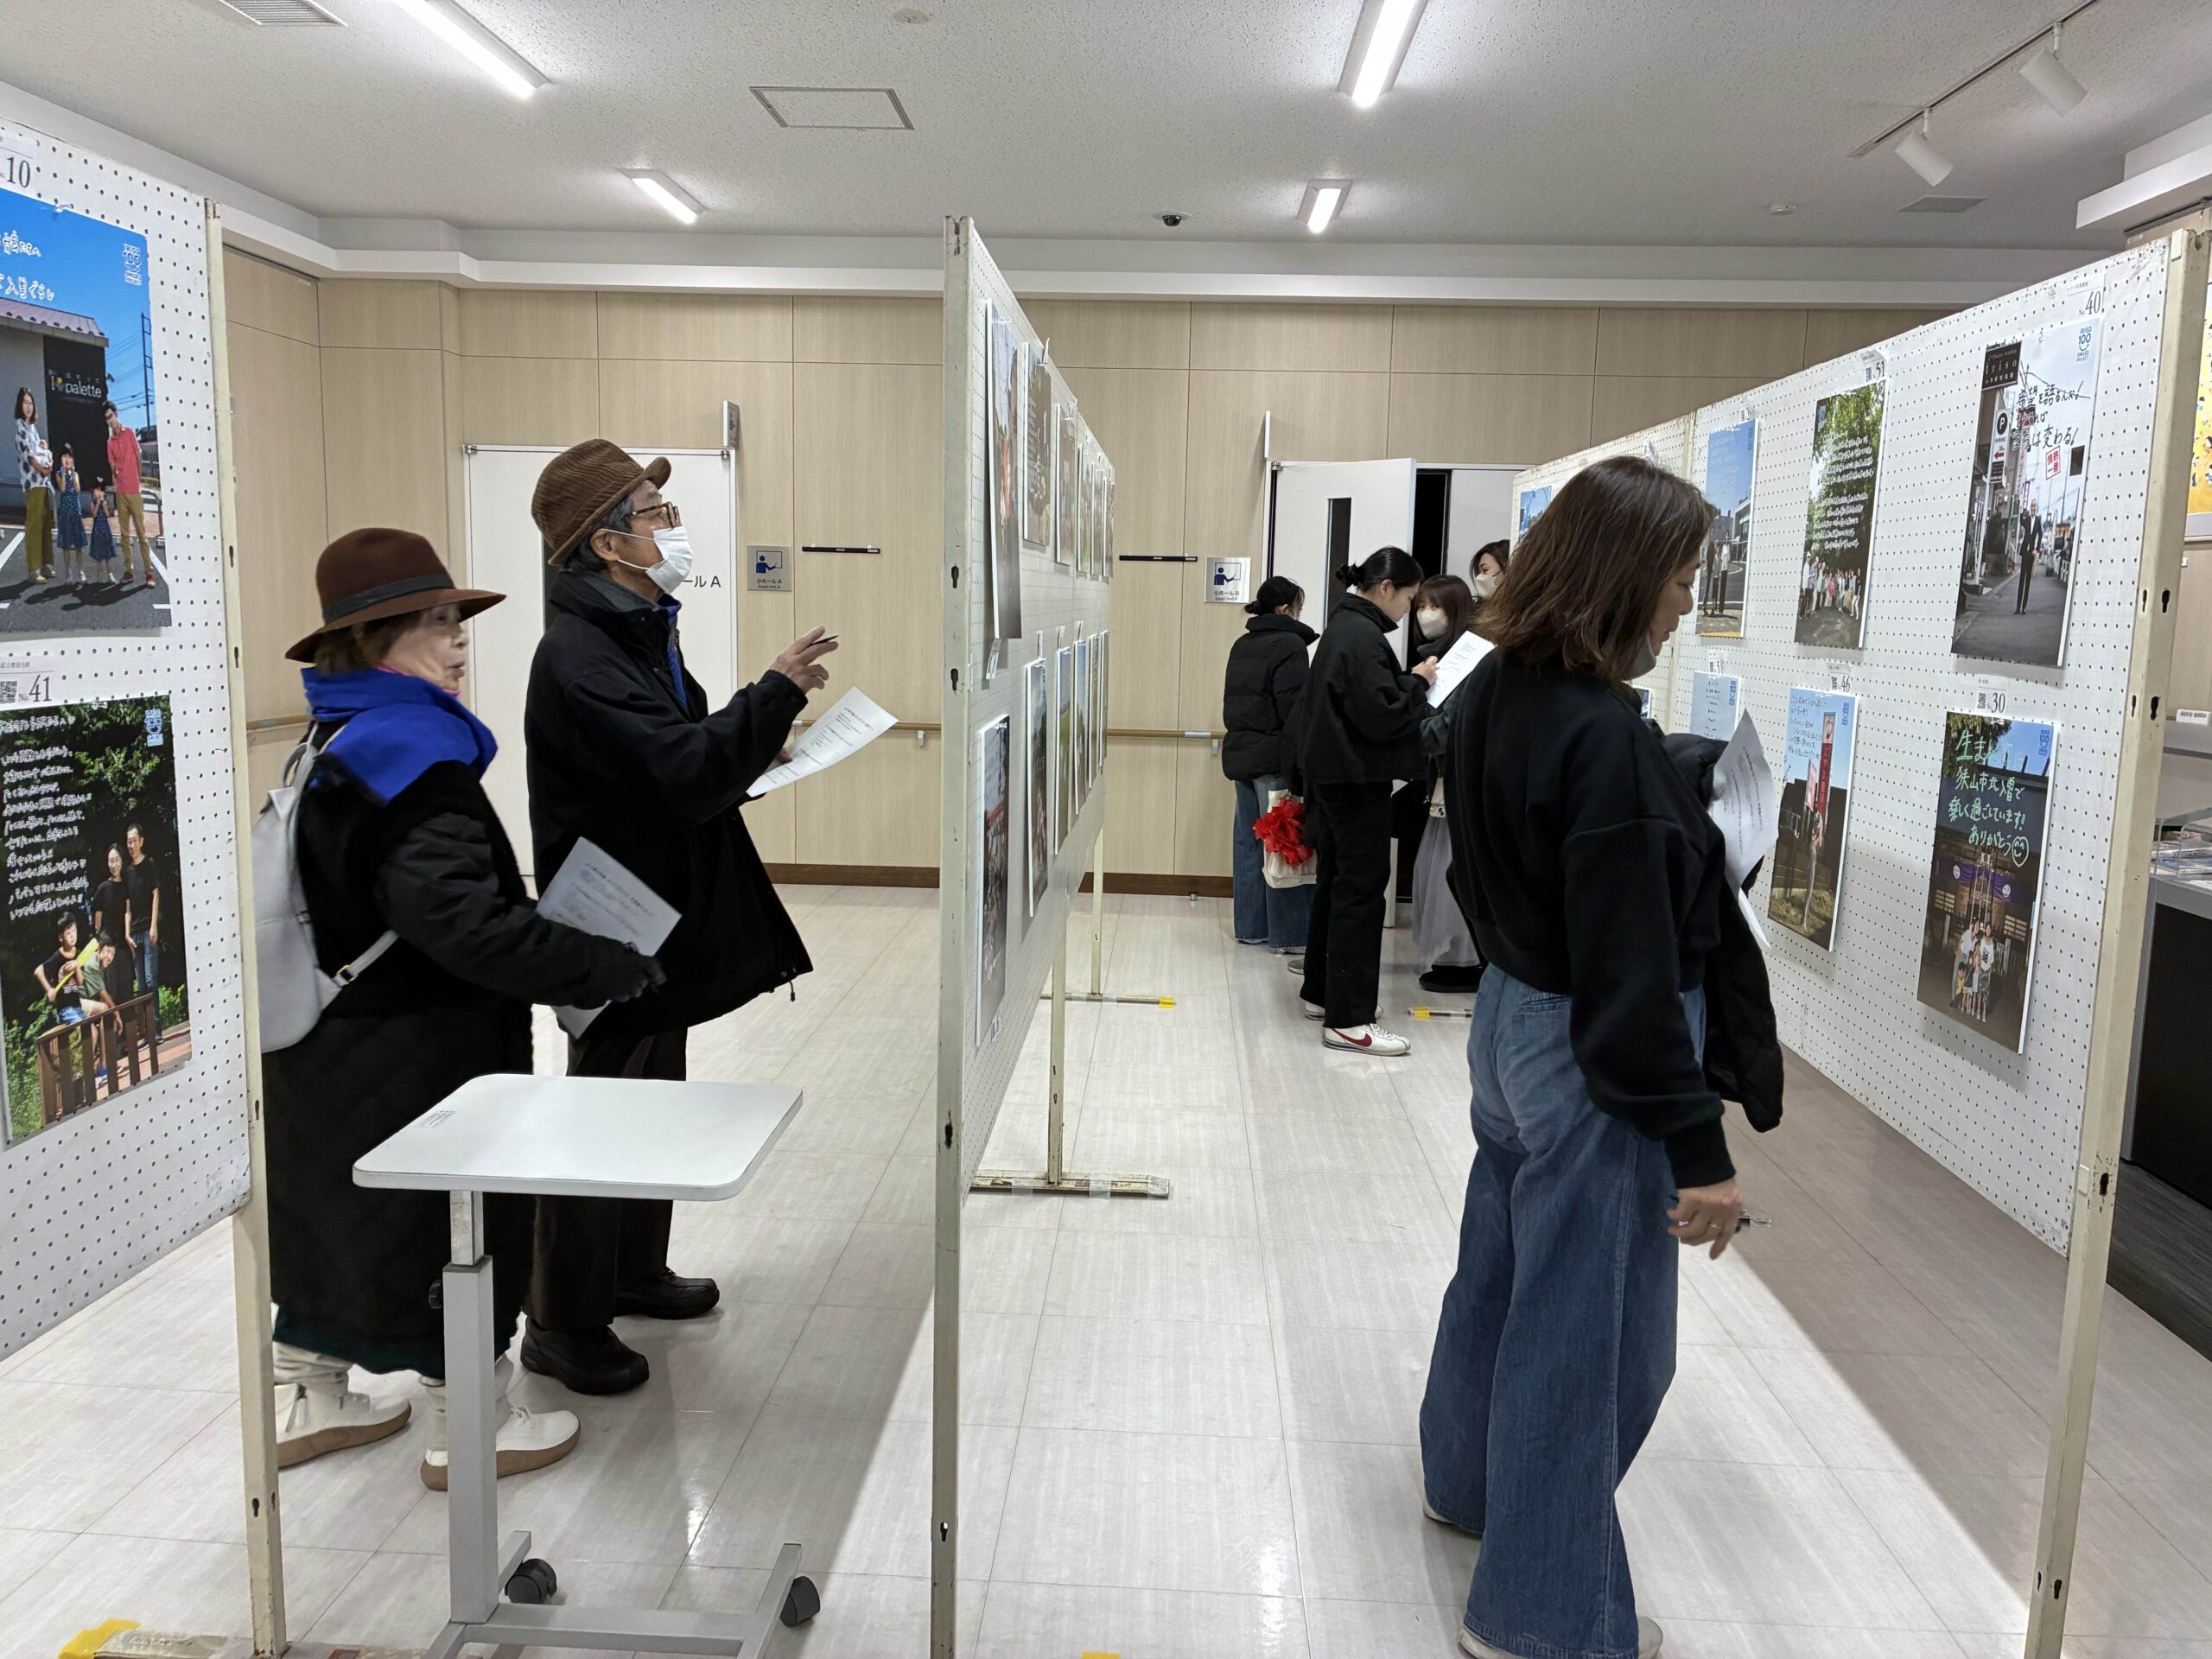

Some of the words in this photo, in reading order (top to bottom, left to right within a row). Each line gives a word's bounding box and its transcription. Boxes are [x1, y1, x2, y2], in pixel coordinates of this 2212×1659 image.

[7, 156, 30, 188] 10
[2078, 333, 2091, 346] 100
[1986, 359, 2018, 375] iriso
[65, 380, 103, 398] palette
[710, 575, 721, 588] A
[1968, 824, 2012, 856] ありがとう
